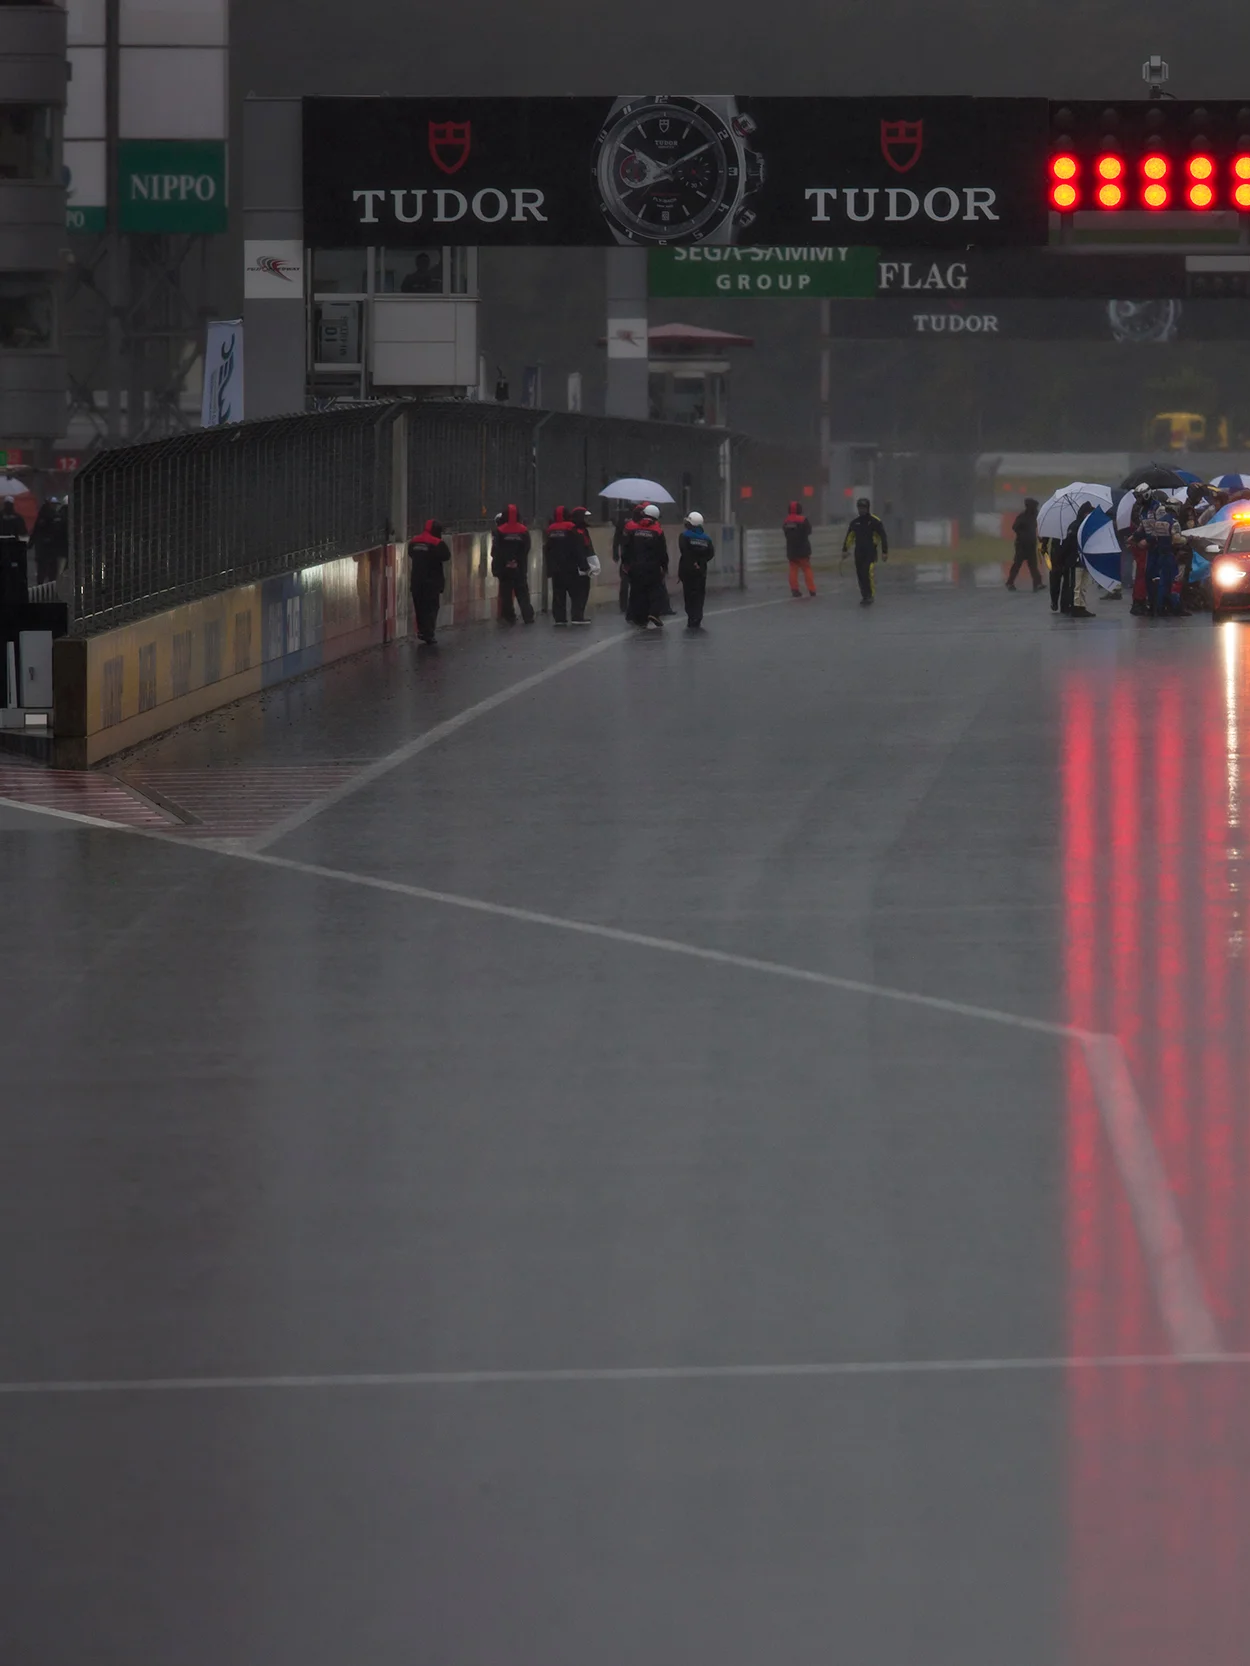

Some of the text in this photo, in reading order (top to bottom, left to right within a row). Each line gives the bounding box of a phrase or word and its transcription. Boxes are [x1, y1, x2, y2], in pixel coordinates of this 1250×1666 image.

[130, 174, 216, 201] NIPPO
[352, 187, 549, 223] TUDOR
[804, 186, 1000, 222] TUDOR
[715, 274, 811, 290] GROUP
[878, 262, 969, 290] FLAG
[913, 314, 999, 332] TUDOR
[59, 457, 77, 470] 12
